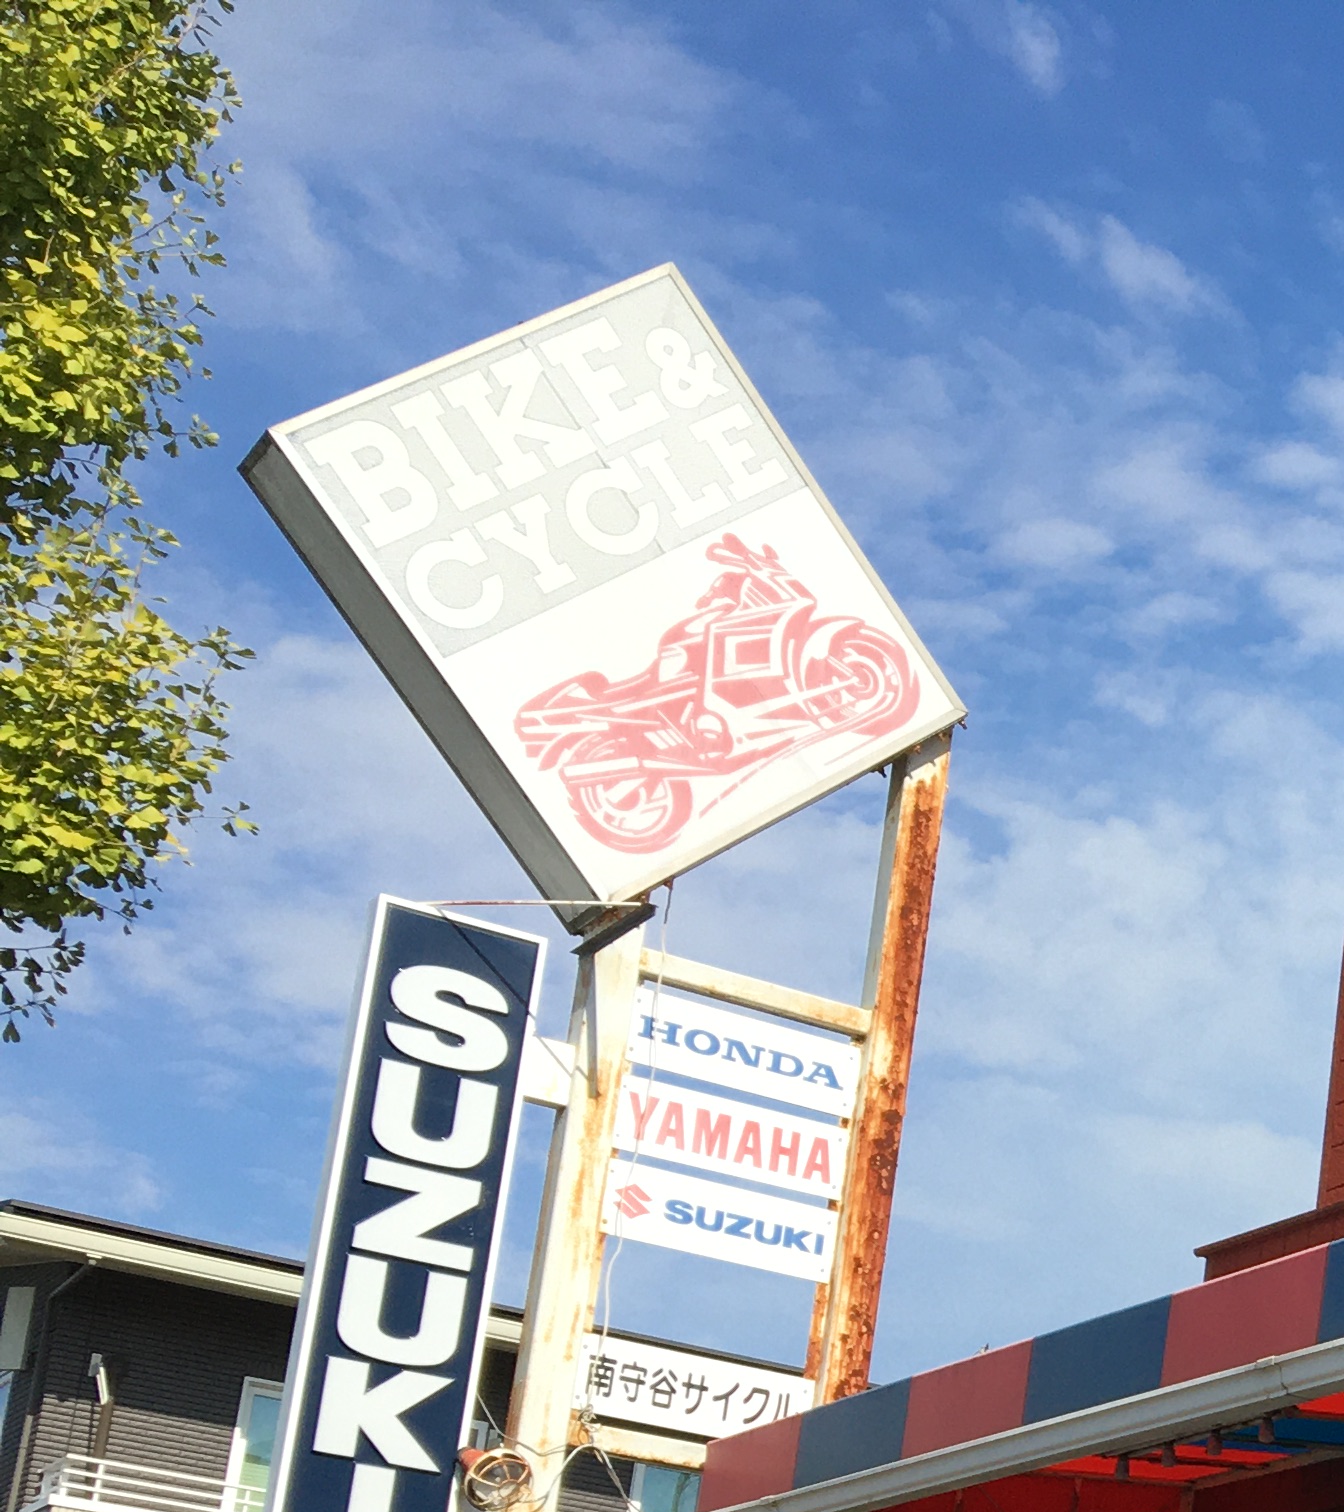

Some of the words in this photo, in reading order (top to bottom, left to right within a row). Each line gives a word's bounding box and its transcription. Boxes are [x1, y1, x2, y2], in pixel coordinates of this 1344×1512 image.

[404, 404, 790, 630] CYCLE
[637, 1014, 844, 1091] HONDA
[629, 1092, 832, 1185] YAMAHA
[664, 1198, 826, 1256] SUZUKI
[585, 1353, 791, 1425] 南守谷サイクル
